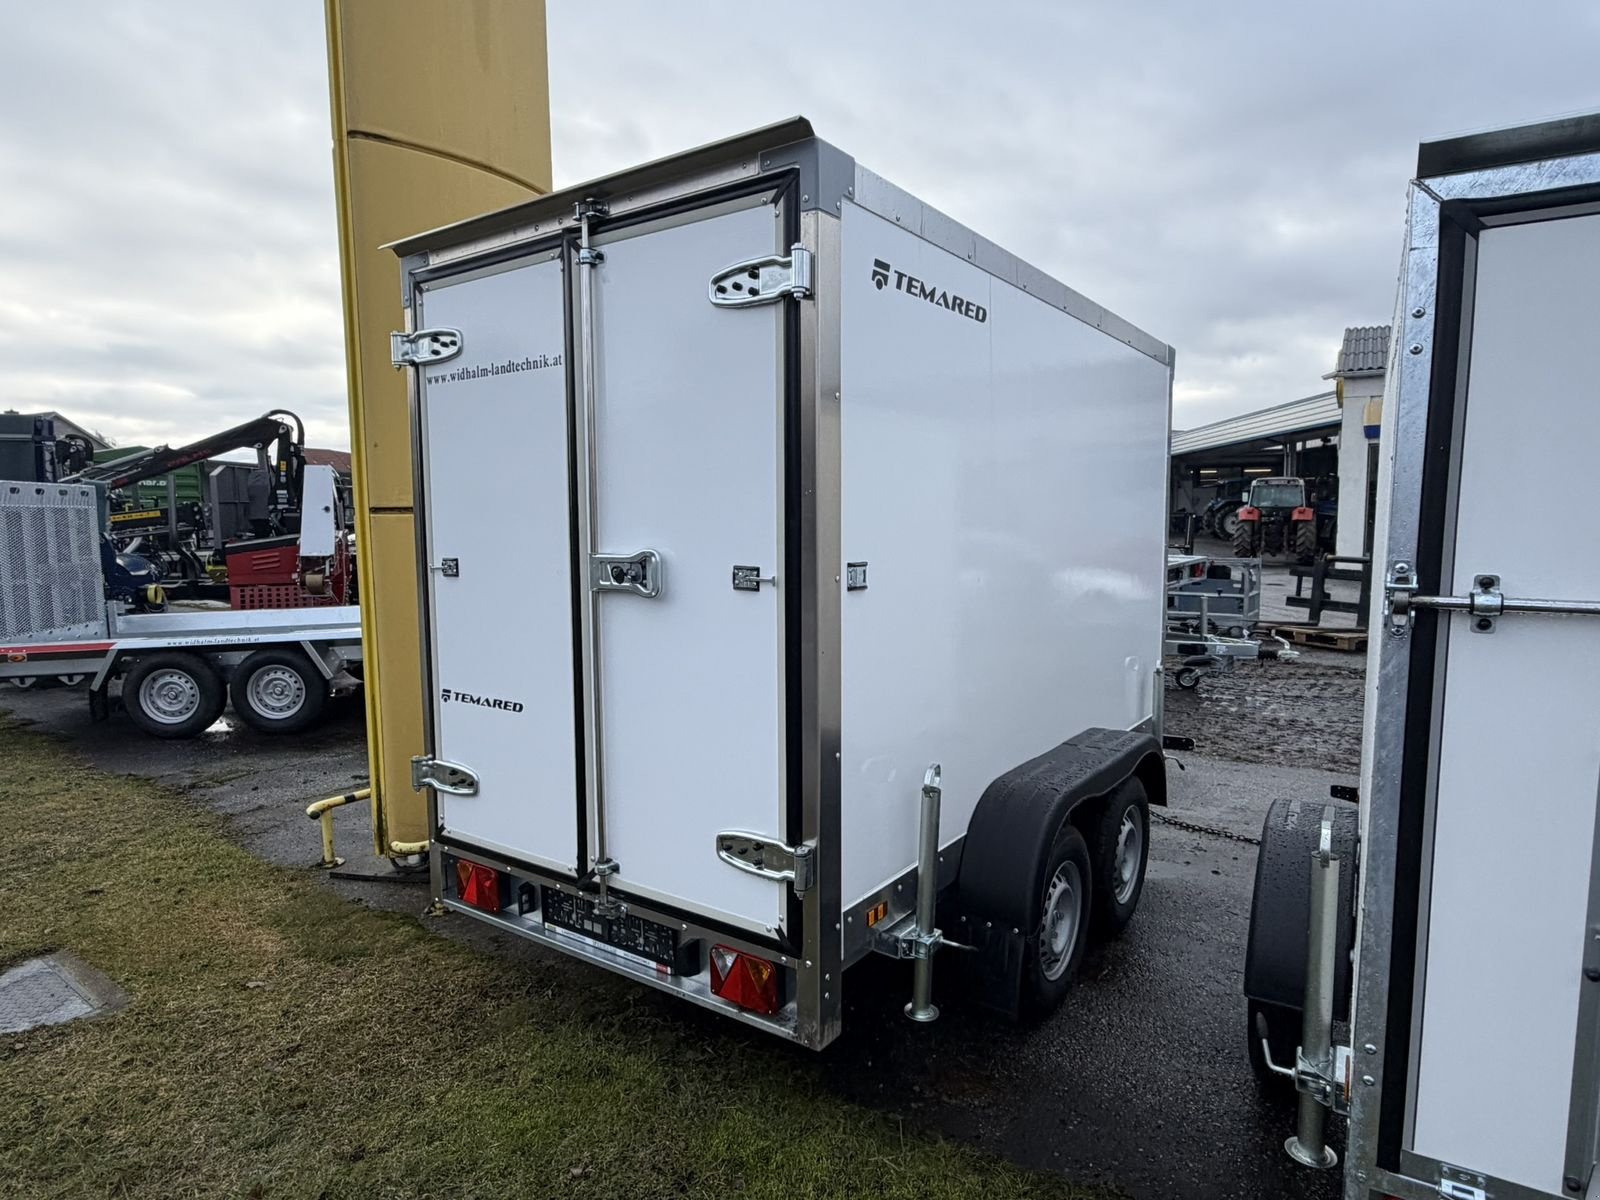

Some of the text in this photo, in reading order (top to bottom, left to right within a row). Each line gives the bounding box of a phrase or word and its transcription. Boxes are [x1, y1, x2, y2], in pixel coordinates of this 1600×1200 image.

[894, 269, 988, 323] TEMARED
[426, 354, 563, 386] www.widhalm-landtechnik.at
[453, 691, 524, 713] TEMARED
